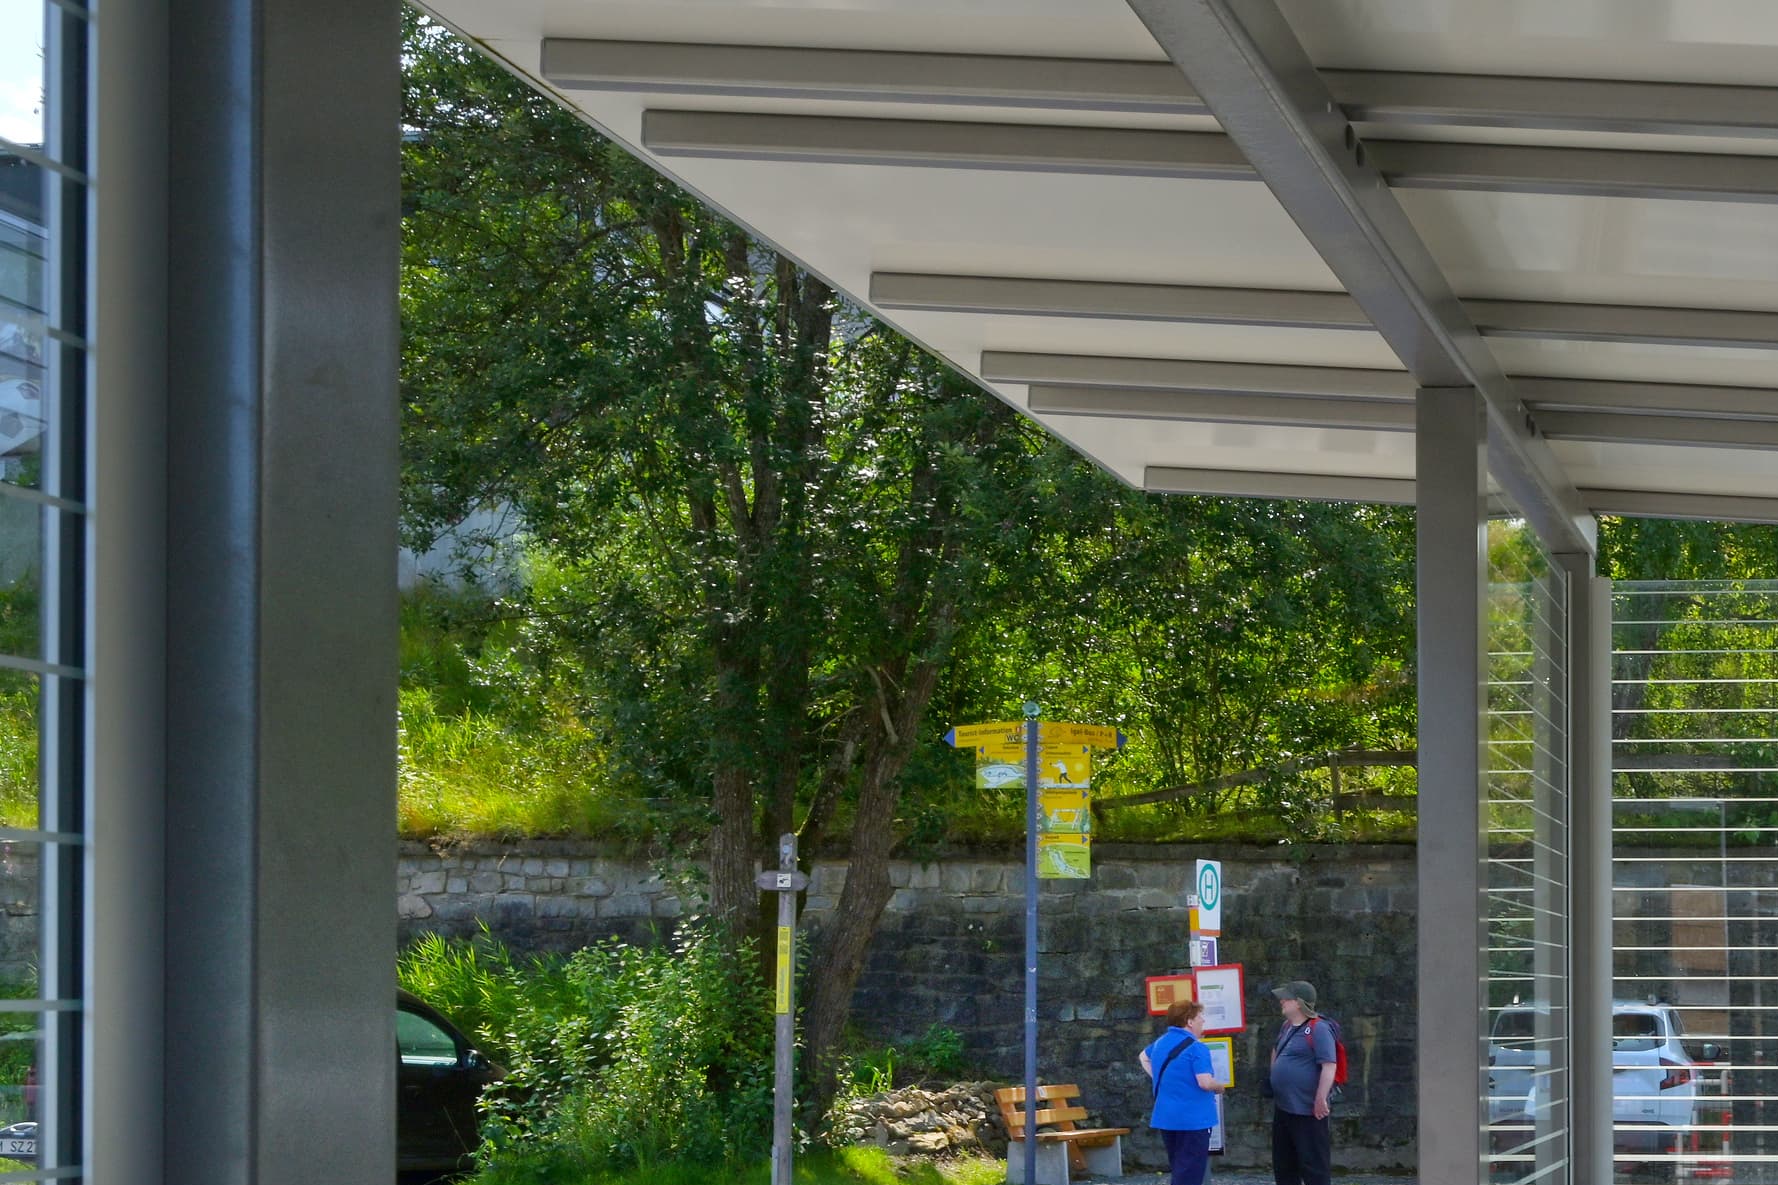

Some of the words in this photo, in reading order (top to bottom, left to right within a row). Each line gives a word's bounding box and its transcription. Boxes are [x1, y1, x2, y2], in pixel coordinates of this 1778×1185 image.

[1006, 734, 1021, 743] WC
[1204, 873, 1214, 901] H
[10, 1141, 24, 1153] SZ
